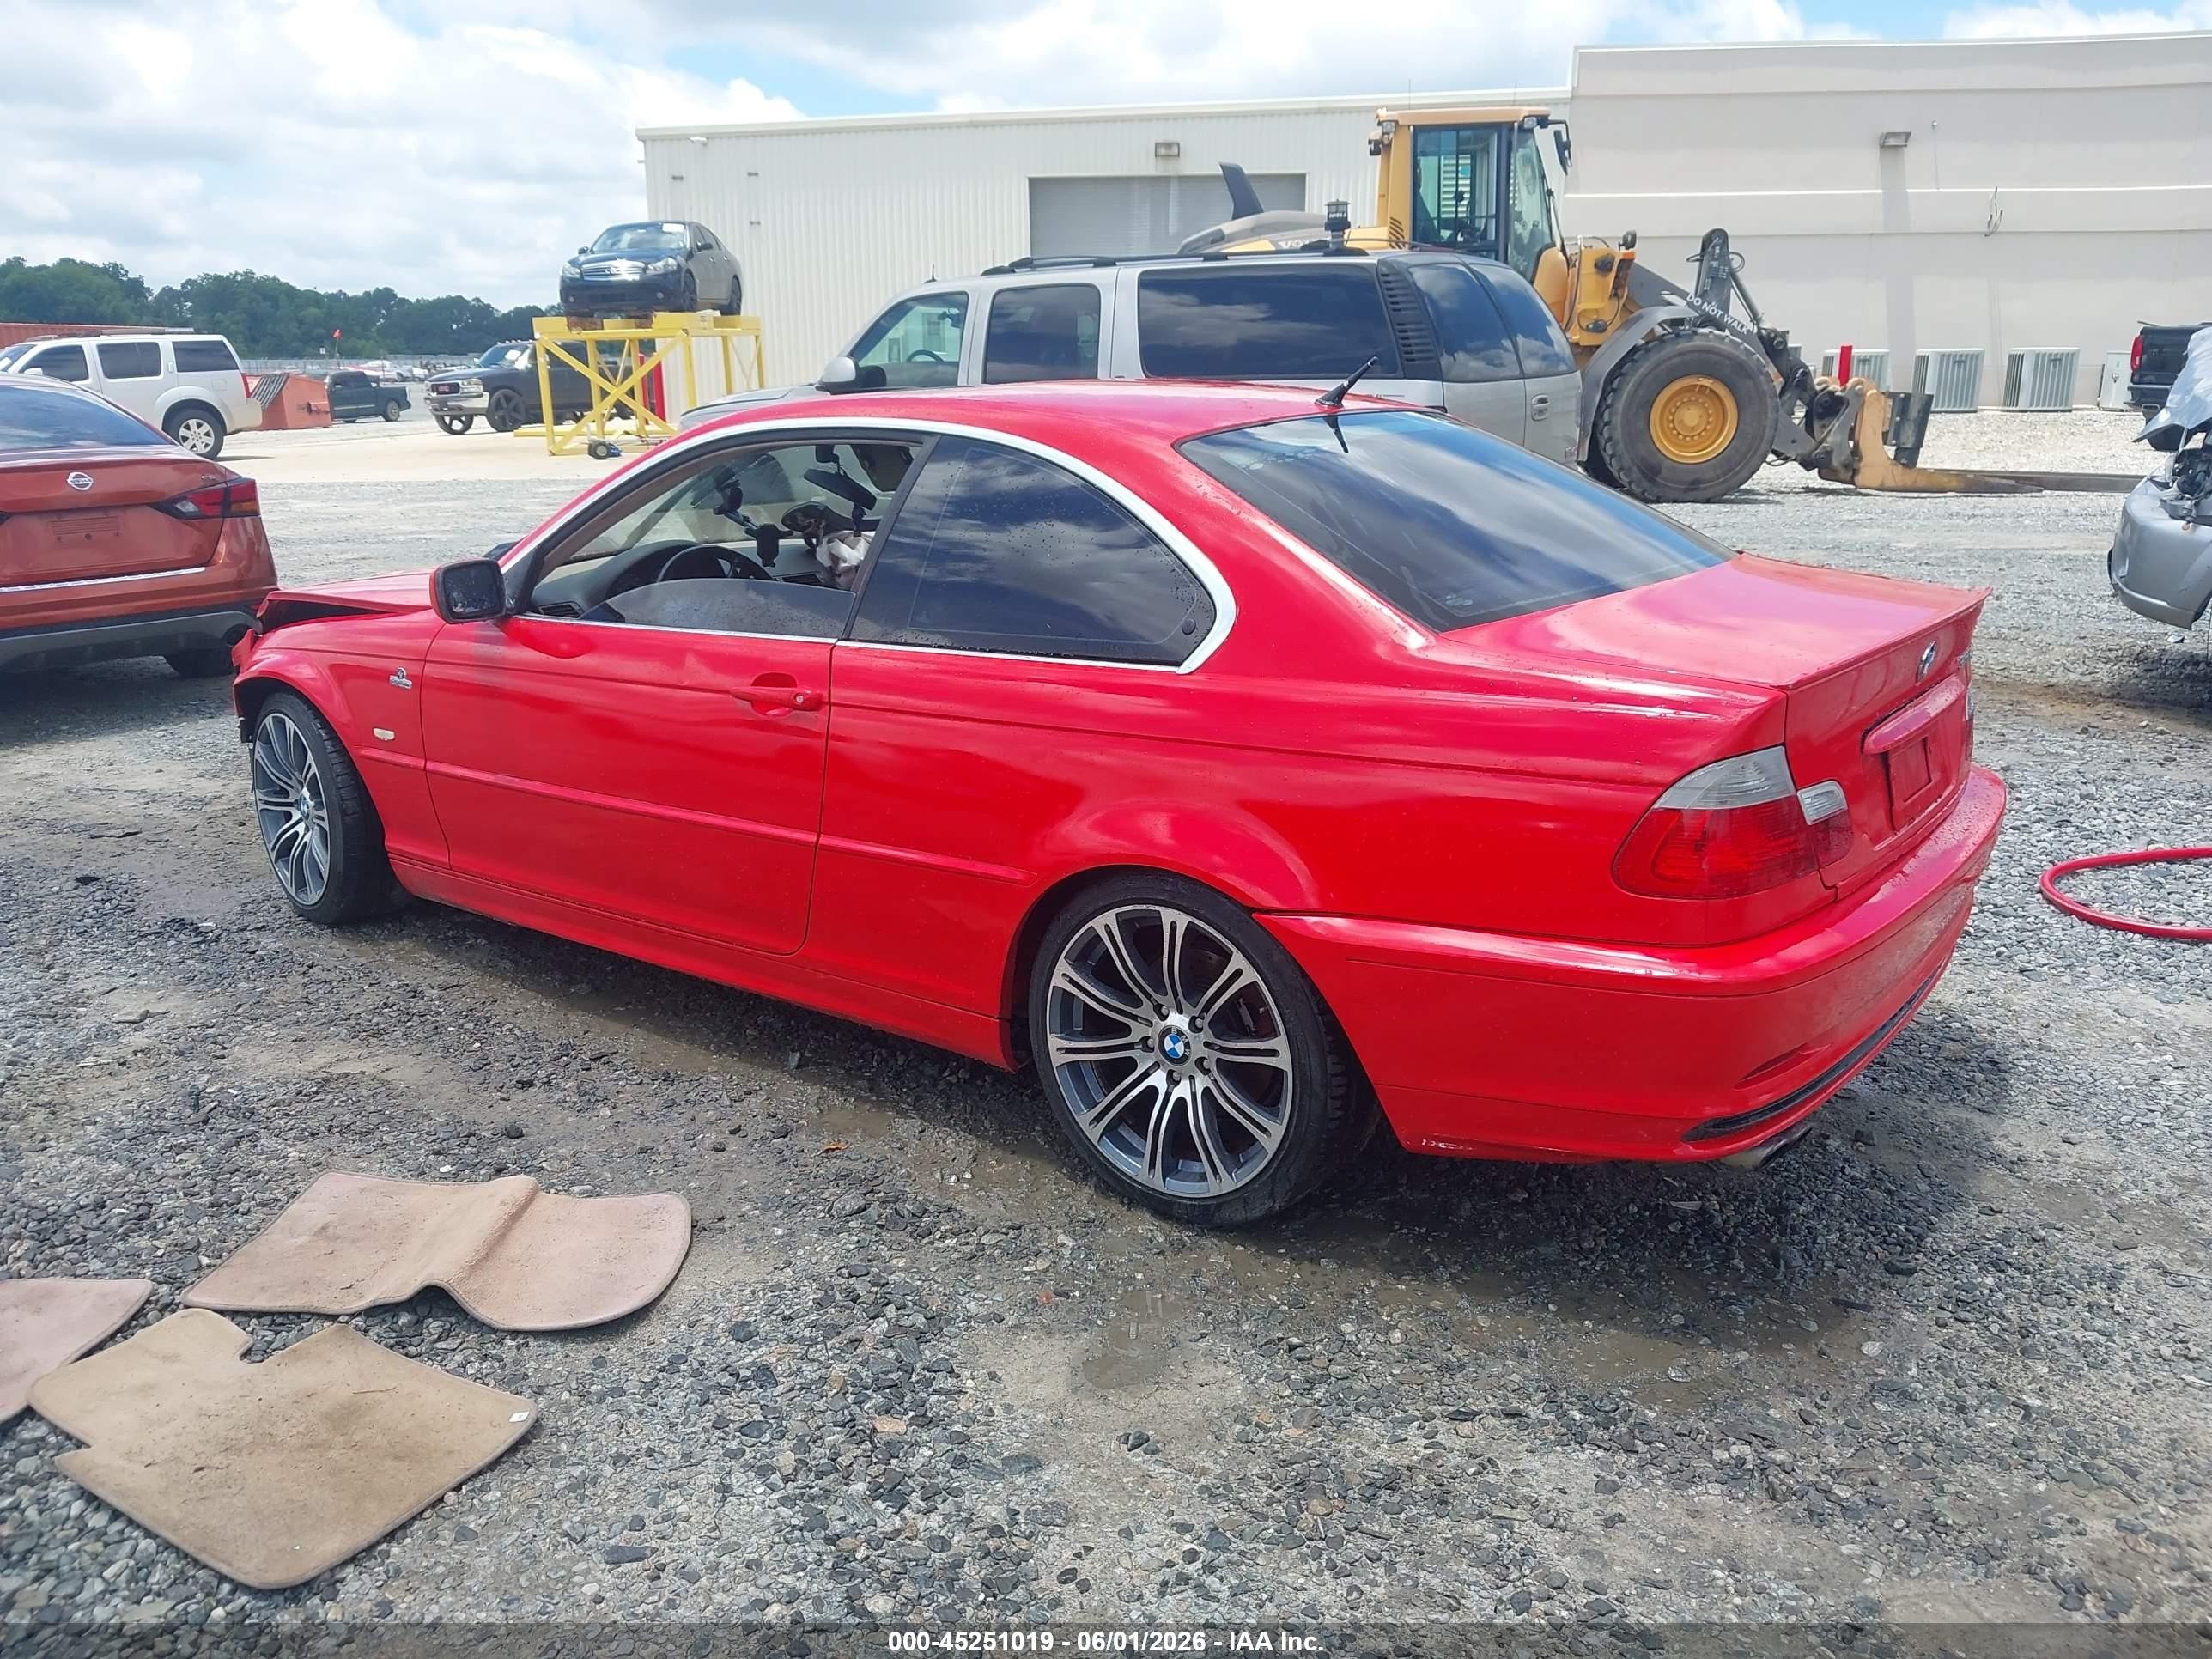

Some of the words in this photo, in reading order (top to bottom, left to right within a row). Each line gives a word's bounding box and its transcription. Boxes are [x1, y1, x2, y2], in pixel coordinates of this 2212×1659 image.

[1686, 294, 1702, 306] DO
[1702, 301, 1723, 318] NOT
[1723, 314, 1749, 335] WALK
[1170, 1026, 1191, 1056] BMW
